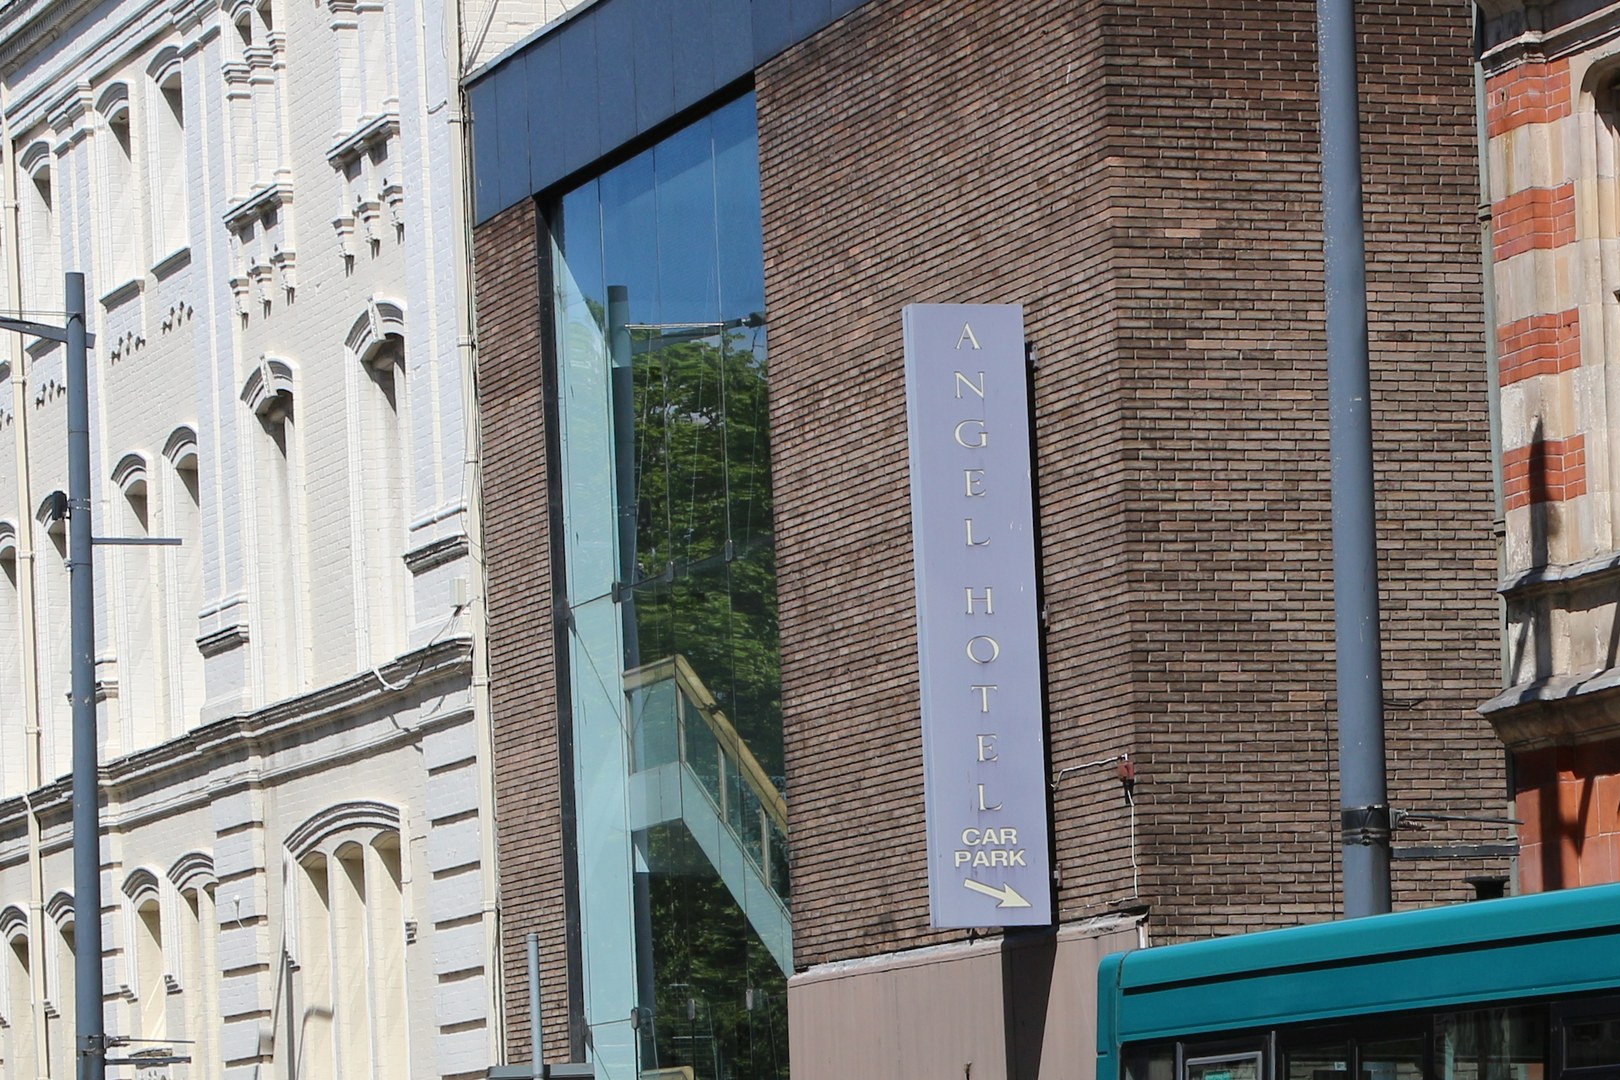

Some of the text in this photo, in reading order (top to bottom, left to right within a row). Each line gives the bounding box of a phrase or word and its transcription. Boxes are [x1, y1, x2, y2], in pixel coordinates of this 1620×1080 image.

[953, 323, 991, 548] ANGEL
[964, 587, 1003, 813] HOTEL
[953, 848, 1027, 869] PARK
[961, 827, 1018, 847] CAR
